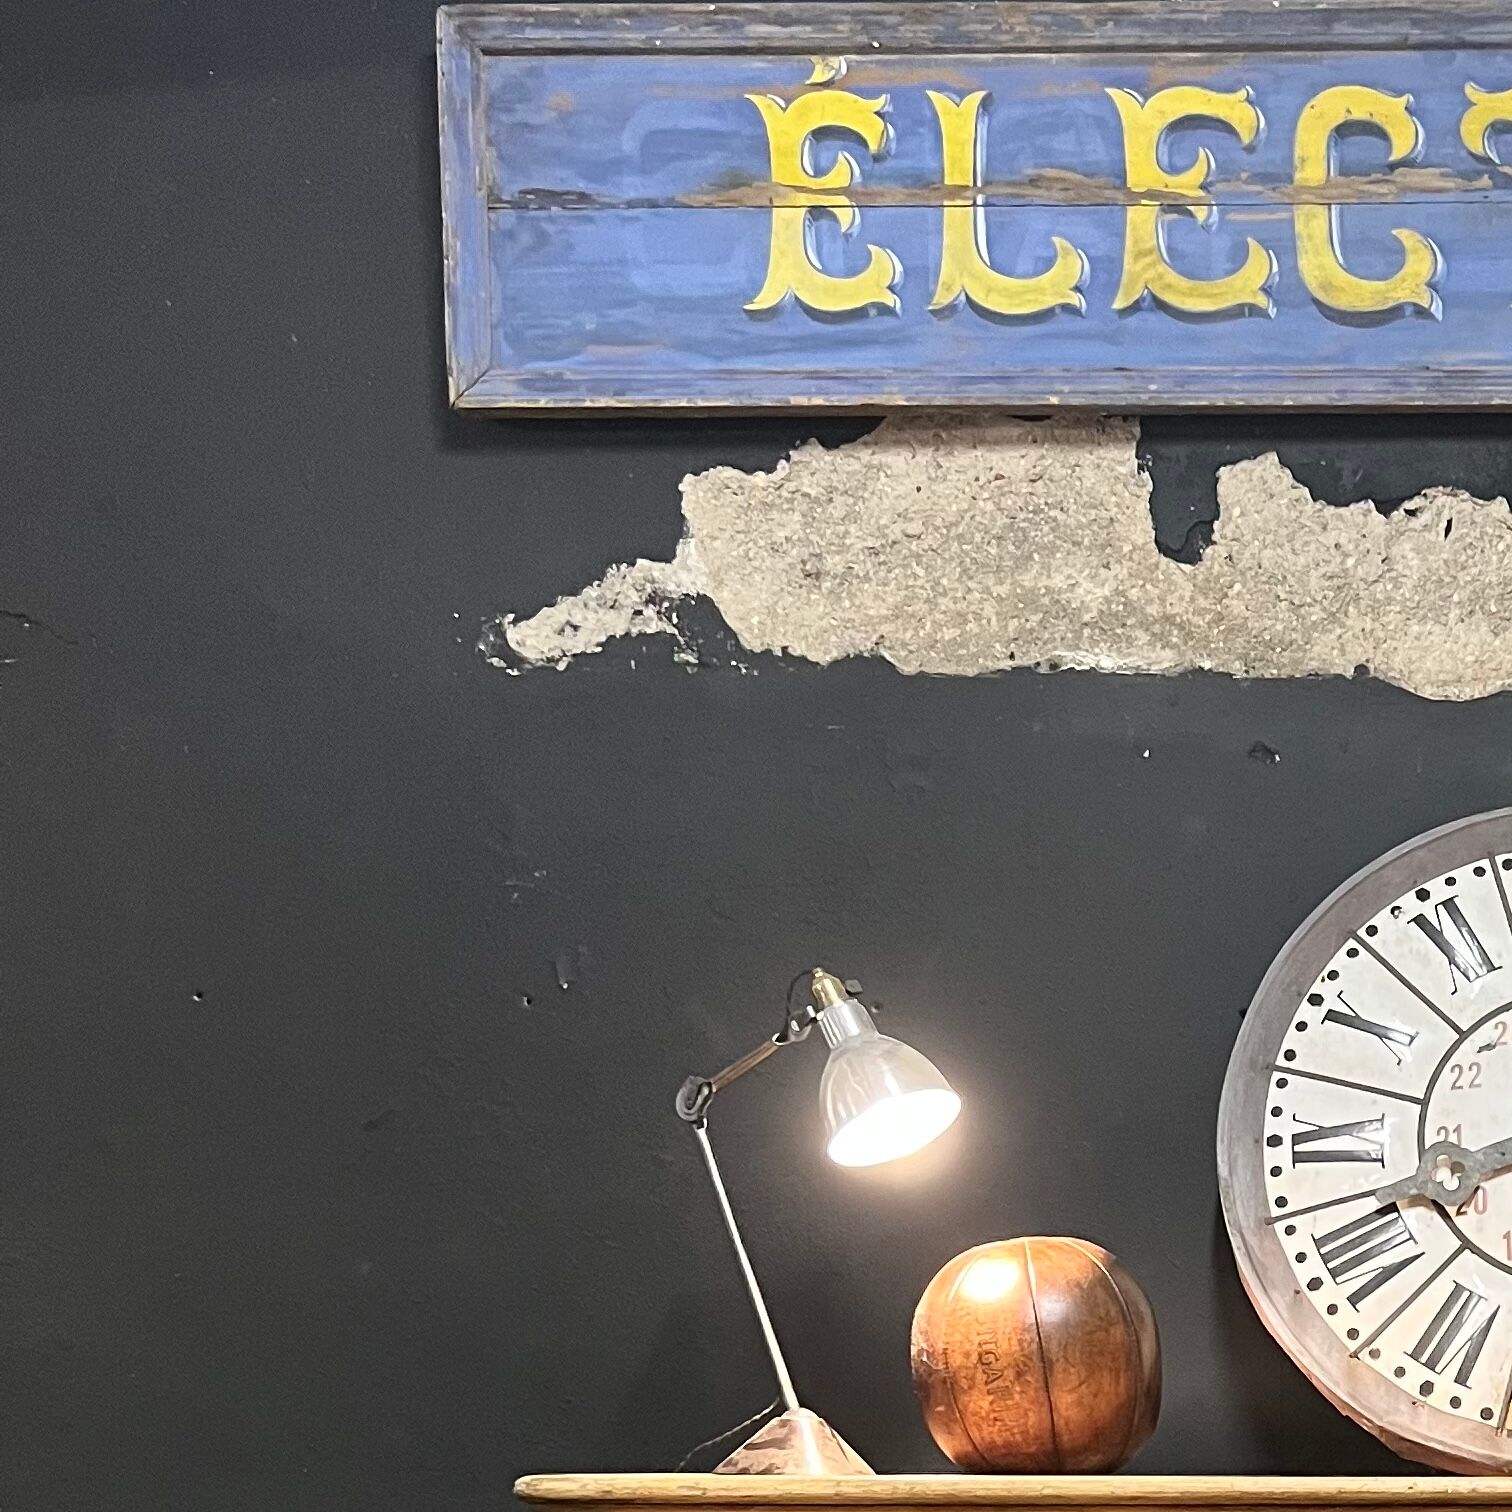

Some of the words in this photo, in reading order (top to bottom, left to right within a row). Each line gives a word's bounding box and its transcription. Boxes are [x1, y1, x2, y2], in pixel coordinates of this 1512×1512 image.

[1407, 895, 1503, 996] XI
[1321, 990, 1420, 1066] X
[1450, 1061, 1483, 1091] 22
[1291, 1113, 1386, 1169] IX
[1311, 1201, 1425, 1313] VIII
[1403, 1280, 1501, 1390] VII
